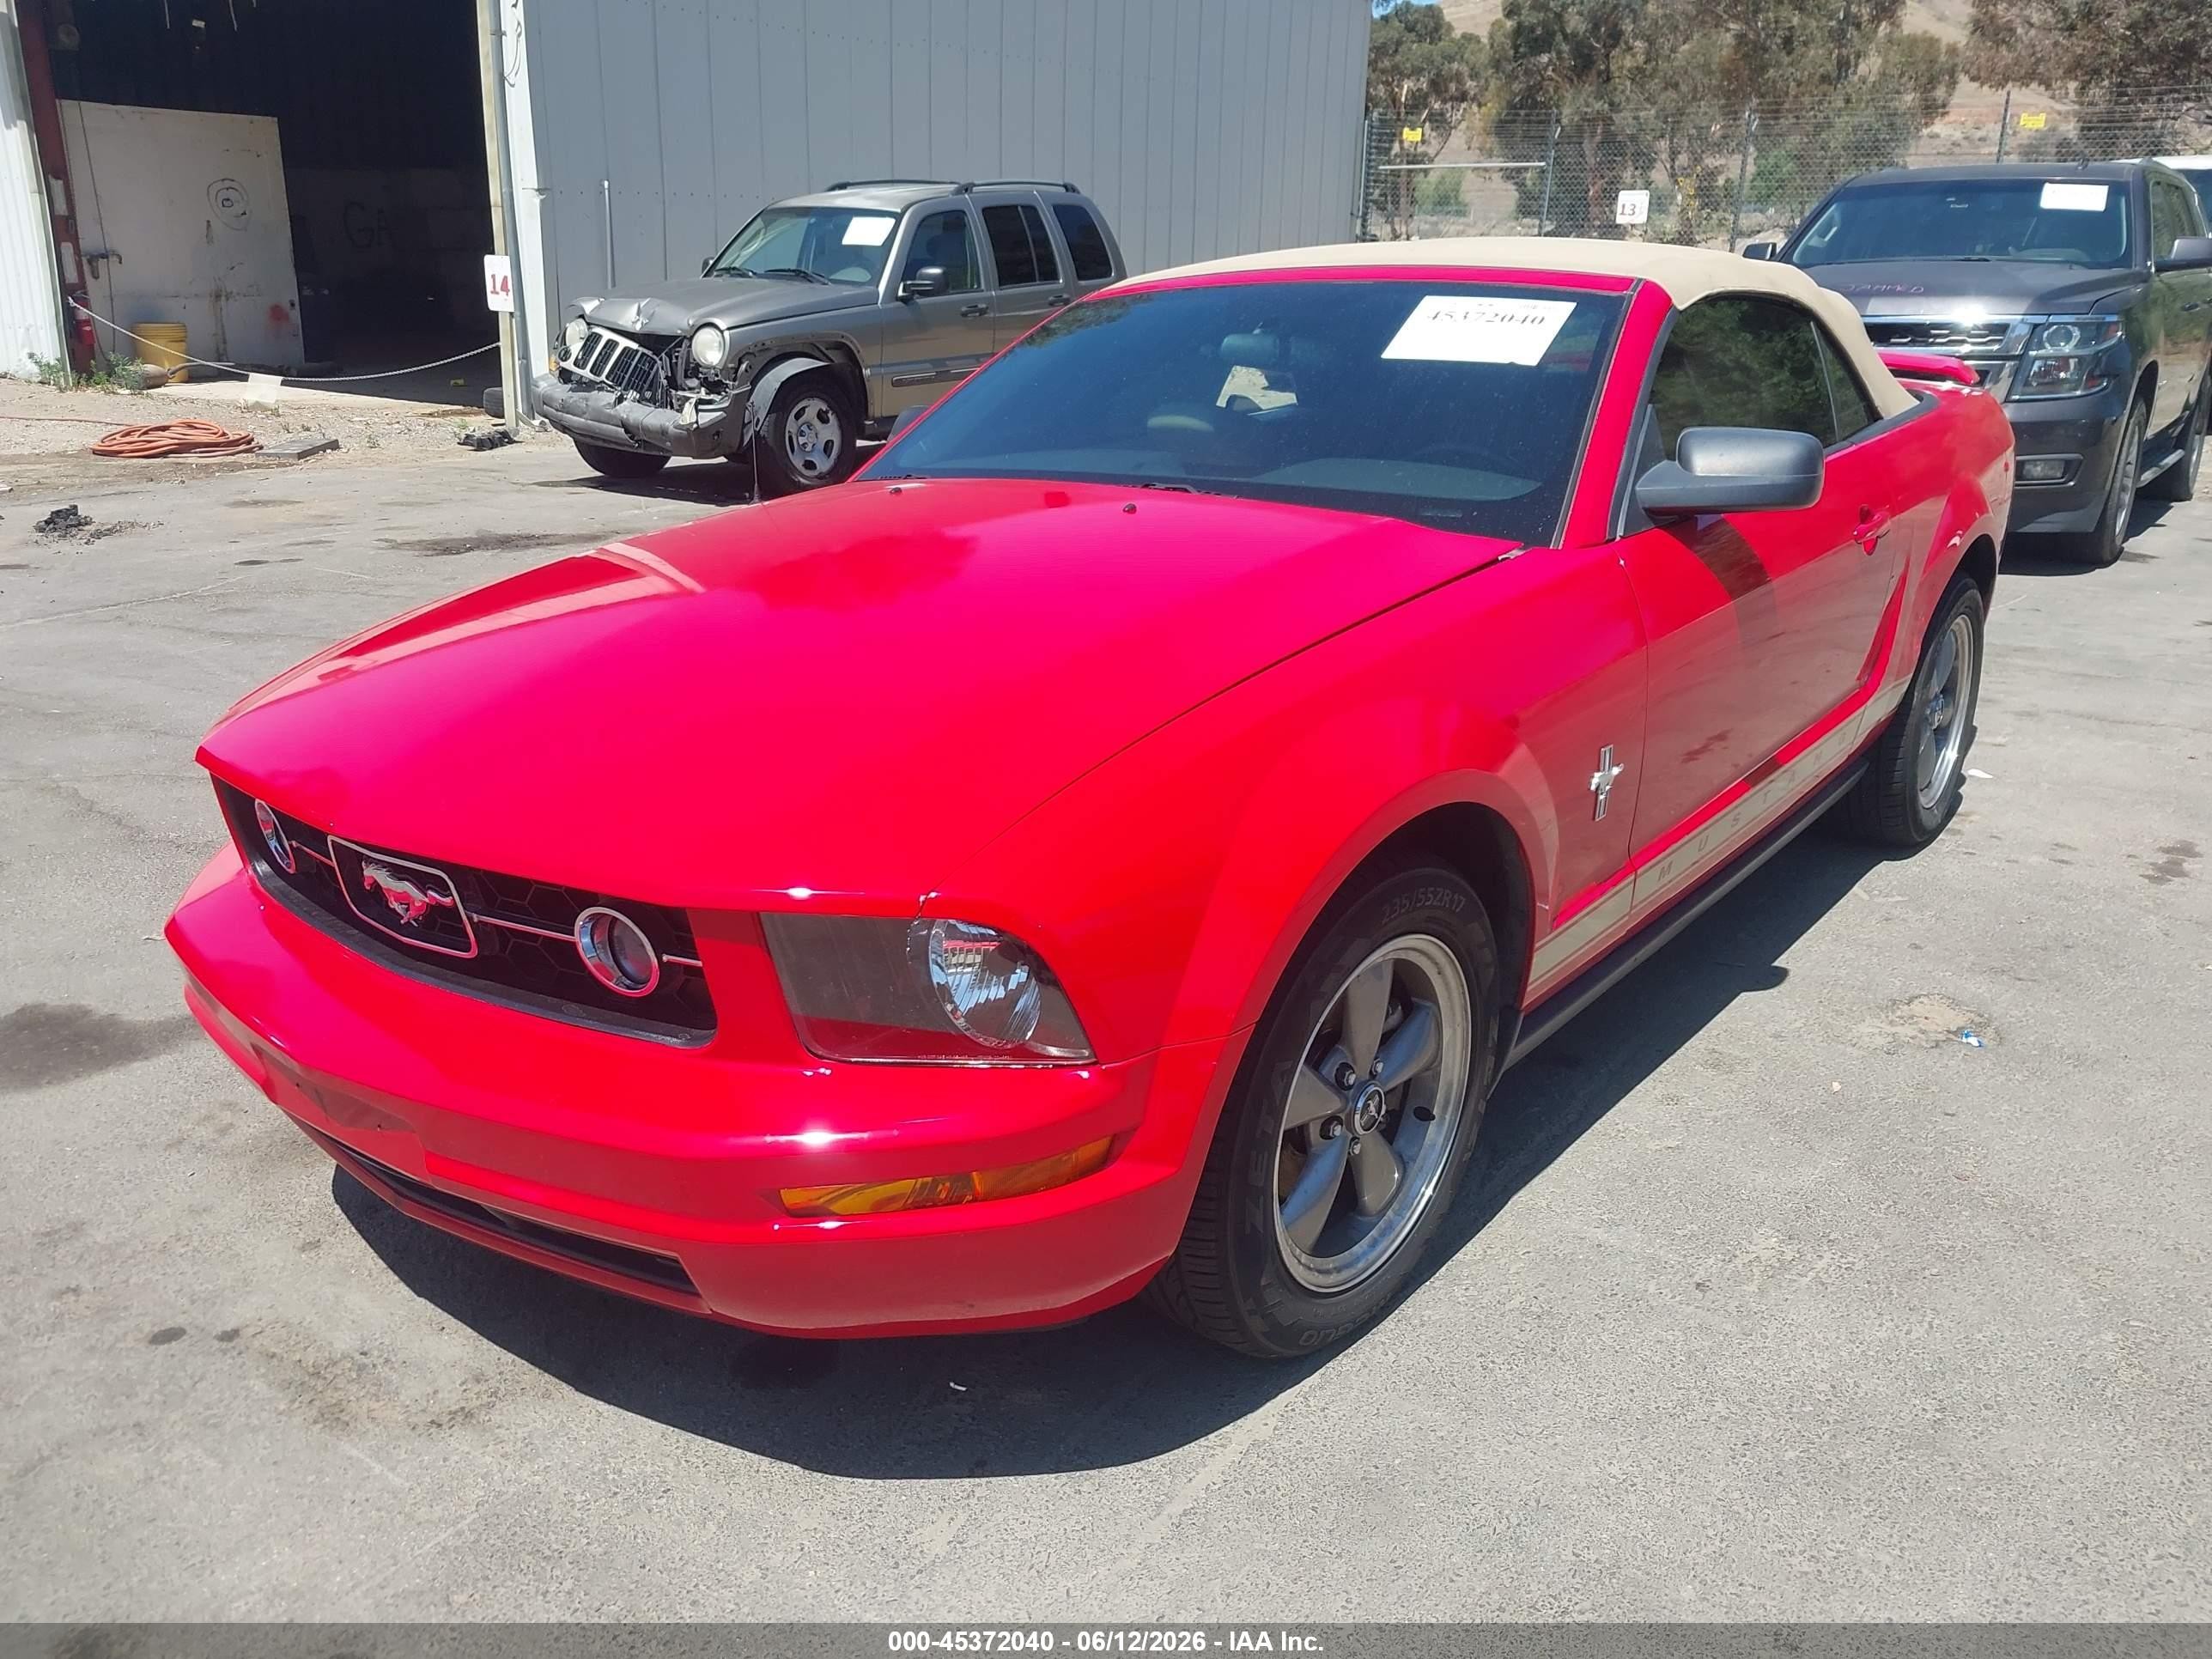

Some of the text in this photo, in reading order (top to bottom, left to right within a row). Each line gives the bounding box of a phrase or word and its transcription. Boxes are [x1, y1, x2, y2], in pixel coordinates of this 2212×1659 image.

[1619, 203, 1636, 216] 13
[489, 273, 511, 297] 14
[1426, 309, 1546, 325] 45372040
[1381, 886, 1467, 927] 235/55ZR17
[1243, 1059, 1297, 1236] ZETA
